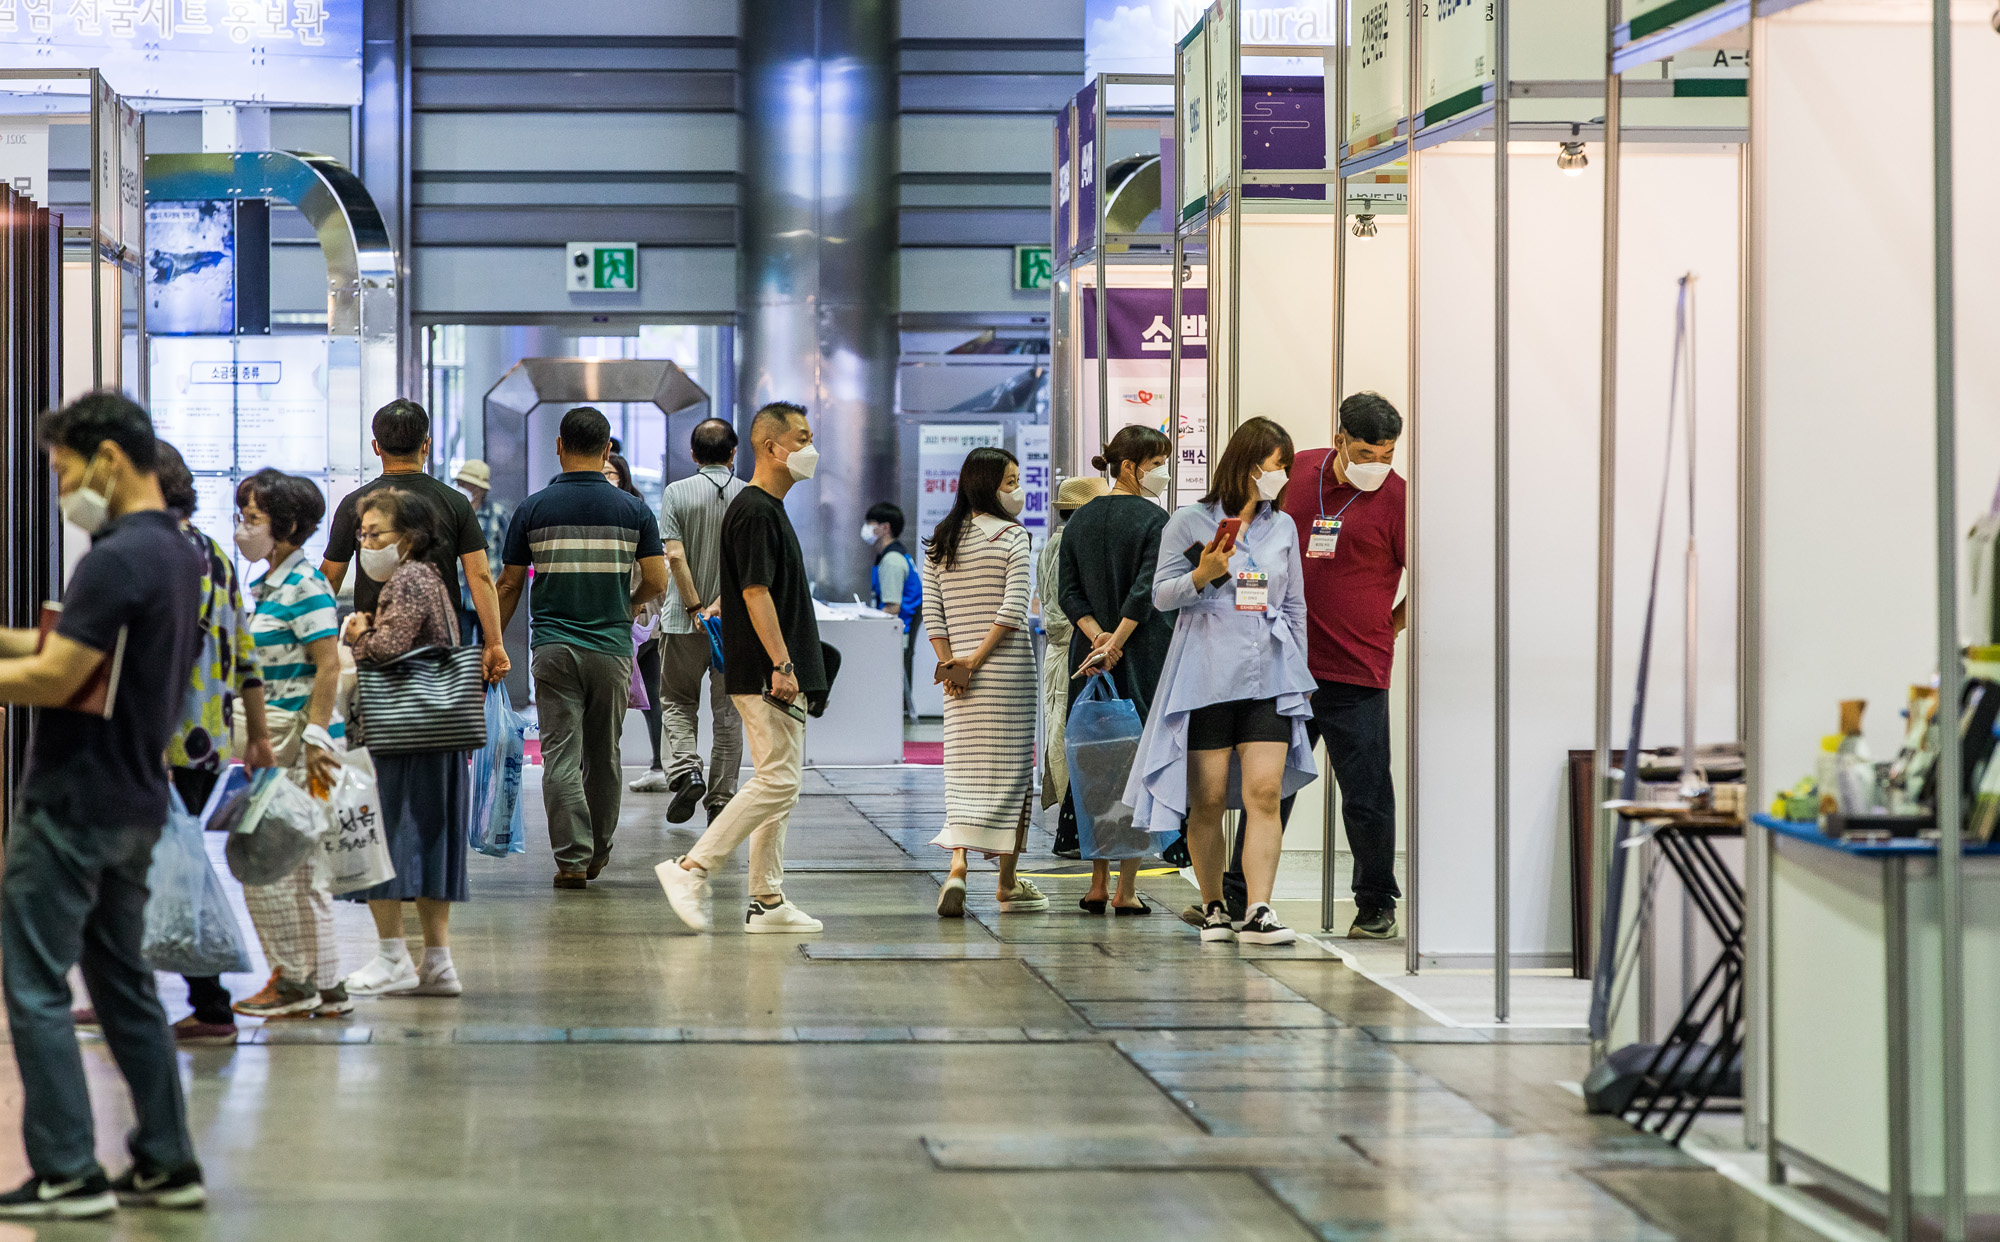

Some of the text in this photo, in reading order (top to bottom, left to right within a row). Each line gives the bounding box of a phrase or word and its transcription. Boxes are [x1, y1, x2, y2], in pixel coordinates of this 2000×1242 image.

[68, 0, 213, 39] 선물세트
[222, 0, 329, 45] 홍보관
[1172, 0, 1336, 42] Nural
[243, 366, 260, 380] 종류
